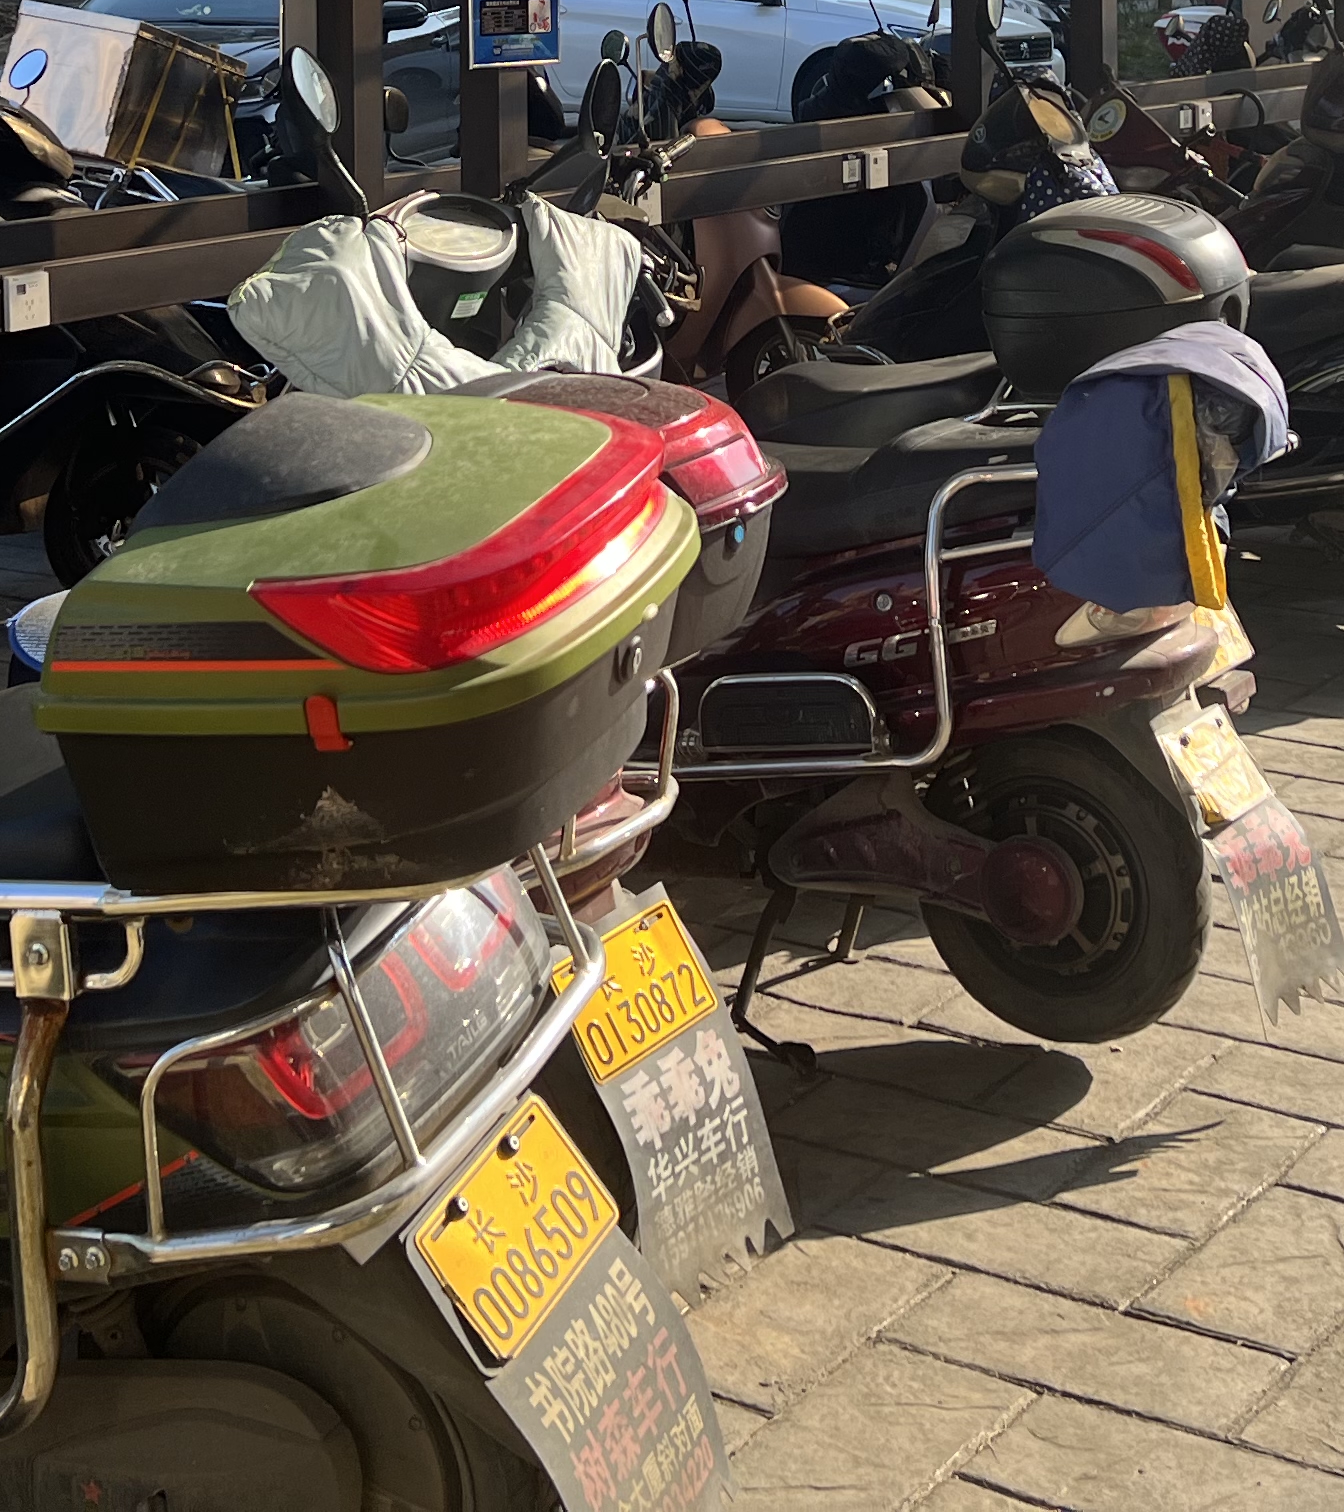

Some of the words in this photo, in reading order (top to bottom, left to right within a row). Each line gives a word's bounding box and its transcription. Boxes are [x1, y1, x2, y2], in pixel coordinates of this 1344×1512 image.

[446, 1013, 489, 1059] TAILG
[586, 963, 706, 1065] 0130872
[620, 1028, 741, 1150] 乖乖兔
[647, 1096, 749, 1202] 华兴车行
[467, 1161, 538, 1254] 长沙
[473, 1170, 599, 1340] 0086509
[525, 1256, 656, 1445] 书院路480号
[570, 1326, 687, 1512] 树森车行
